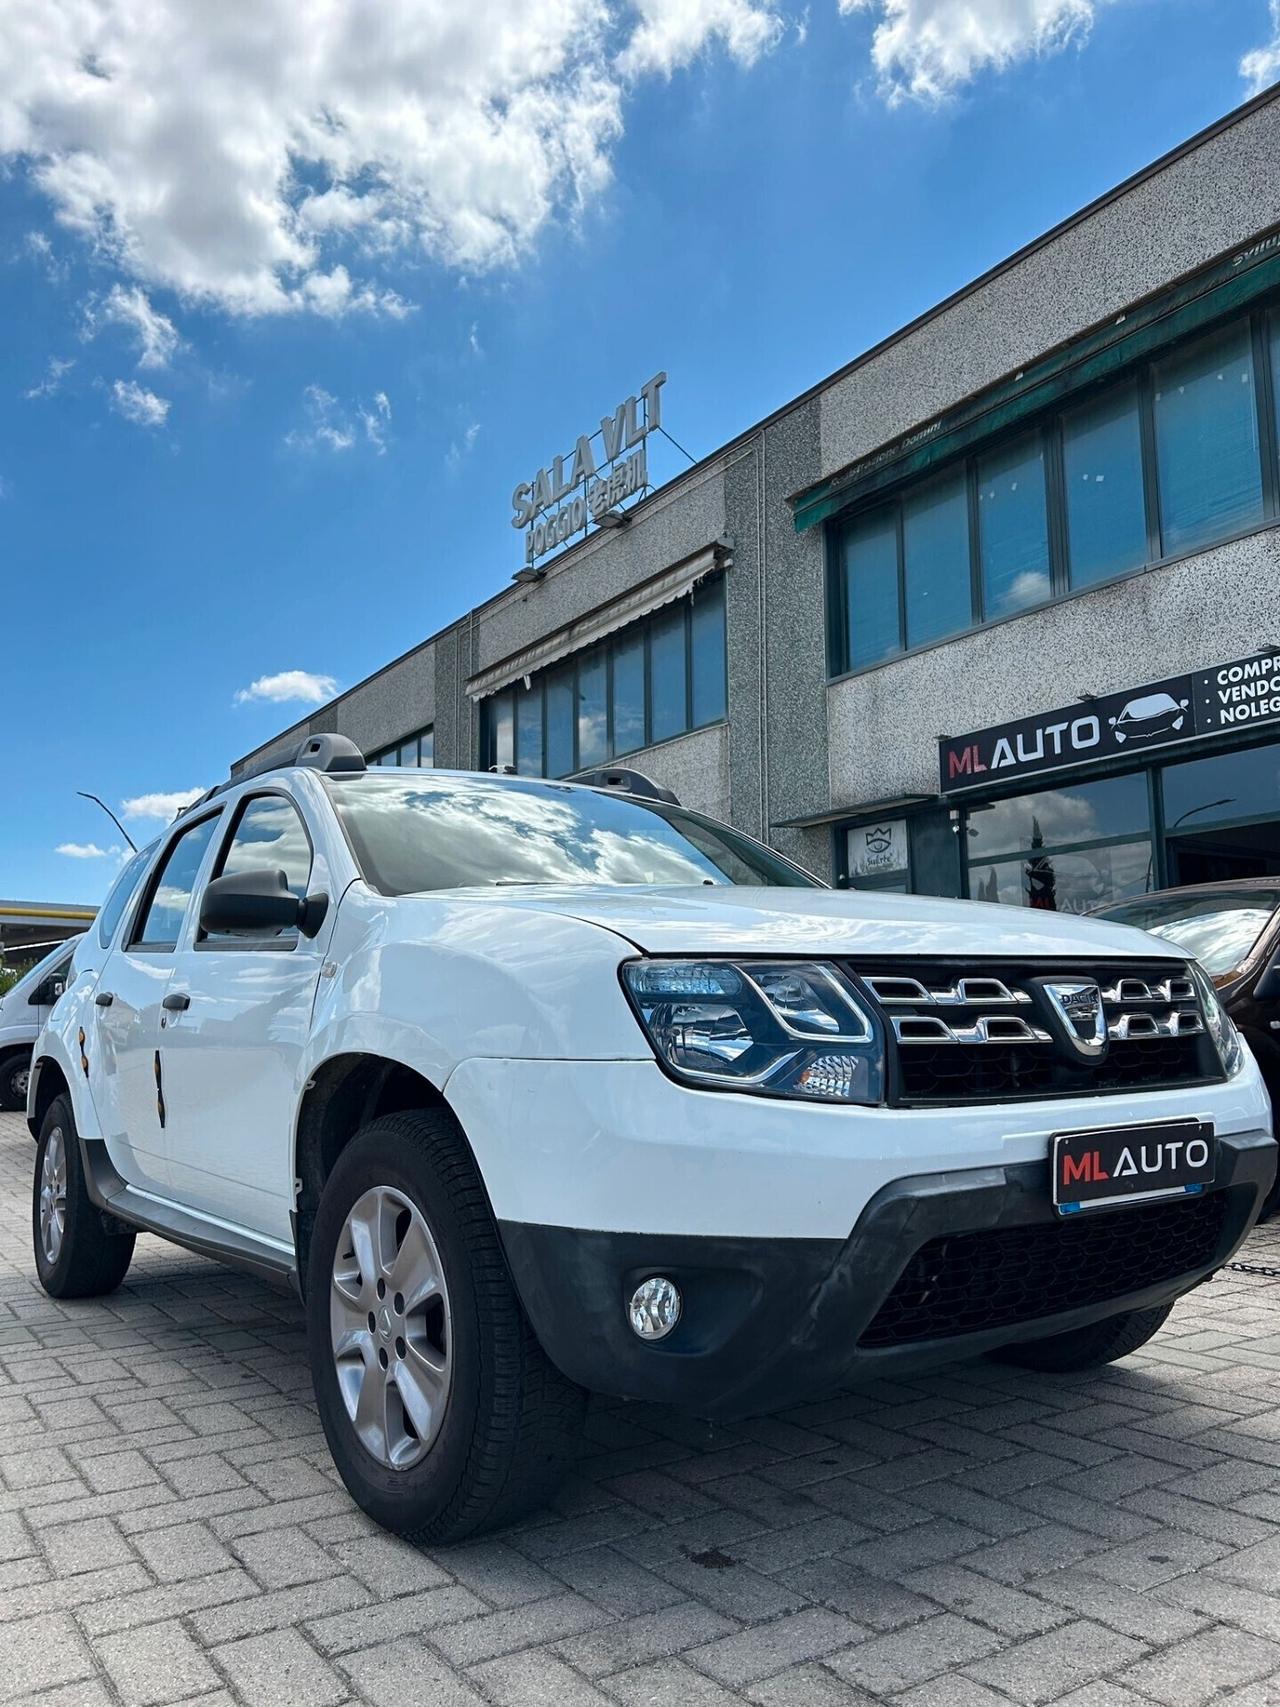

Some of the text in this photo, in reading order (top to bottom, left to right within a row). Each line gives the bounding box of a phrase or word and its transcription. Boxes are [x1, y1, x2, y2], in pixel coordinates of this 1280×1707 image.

[511, 371, 667, 529] SALA VLT
[526, 496, 588, 563] POGGIO
[1220, 696, 1280, 724] NOLEG
[990, 714, 1100, 769] AUTO
[1063, 1138, 1209, 1186] ML AUTO
